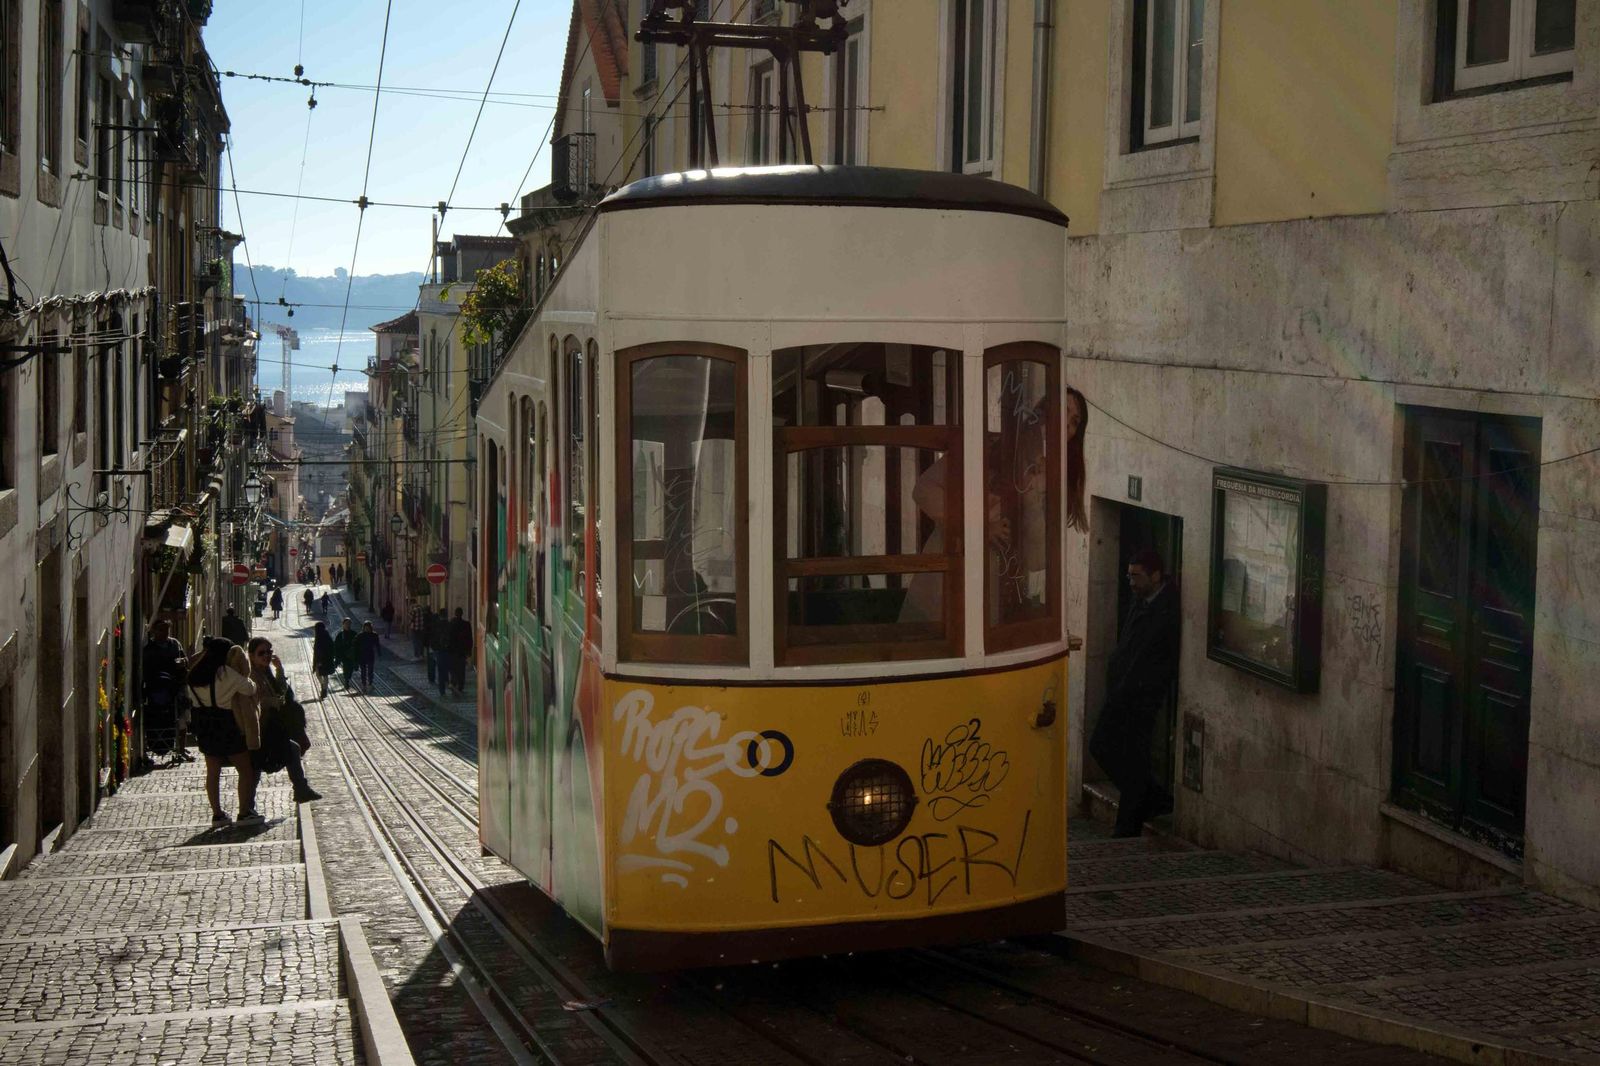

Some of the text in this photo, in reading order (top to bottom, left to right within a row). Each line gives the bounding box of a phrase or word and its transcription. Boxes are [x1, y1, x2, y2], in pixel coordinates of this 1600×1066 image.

[1216, 479, 1247, 492] FREGUESIA
[1248, 485, 1257, 495] DA
[968, 718, 982, 741] 2
